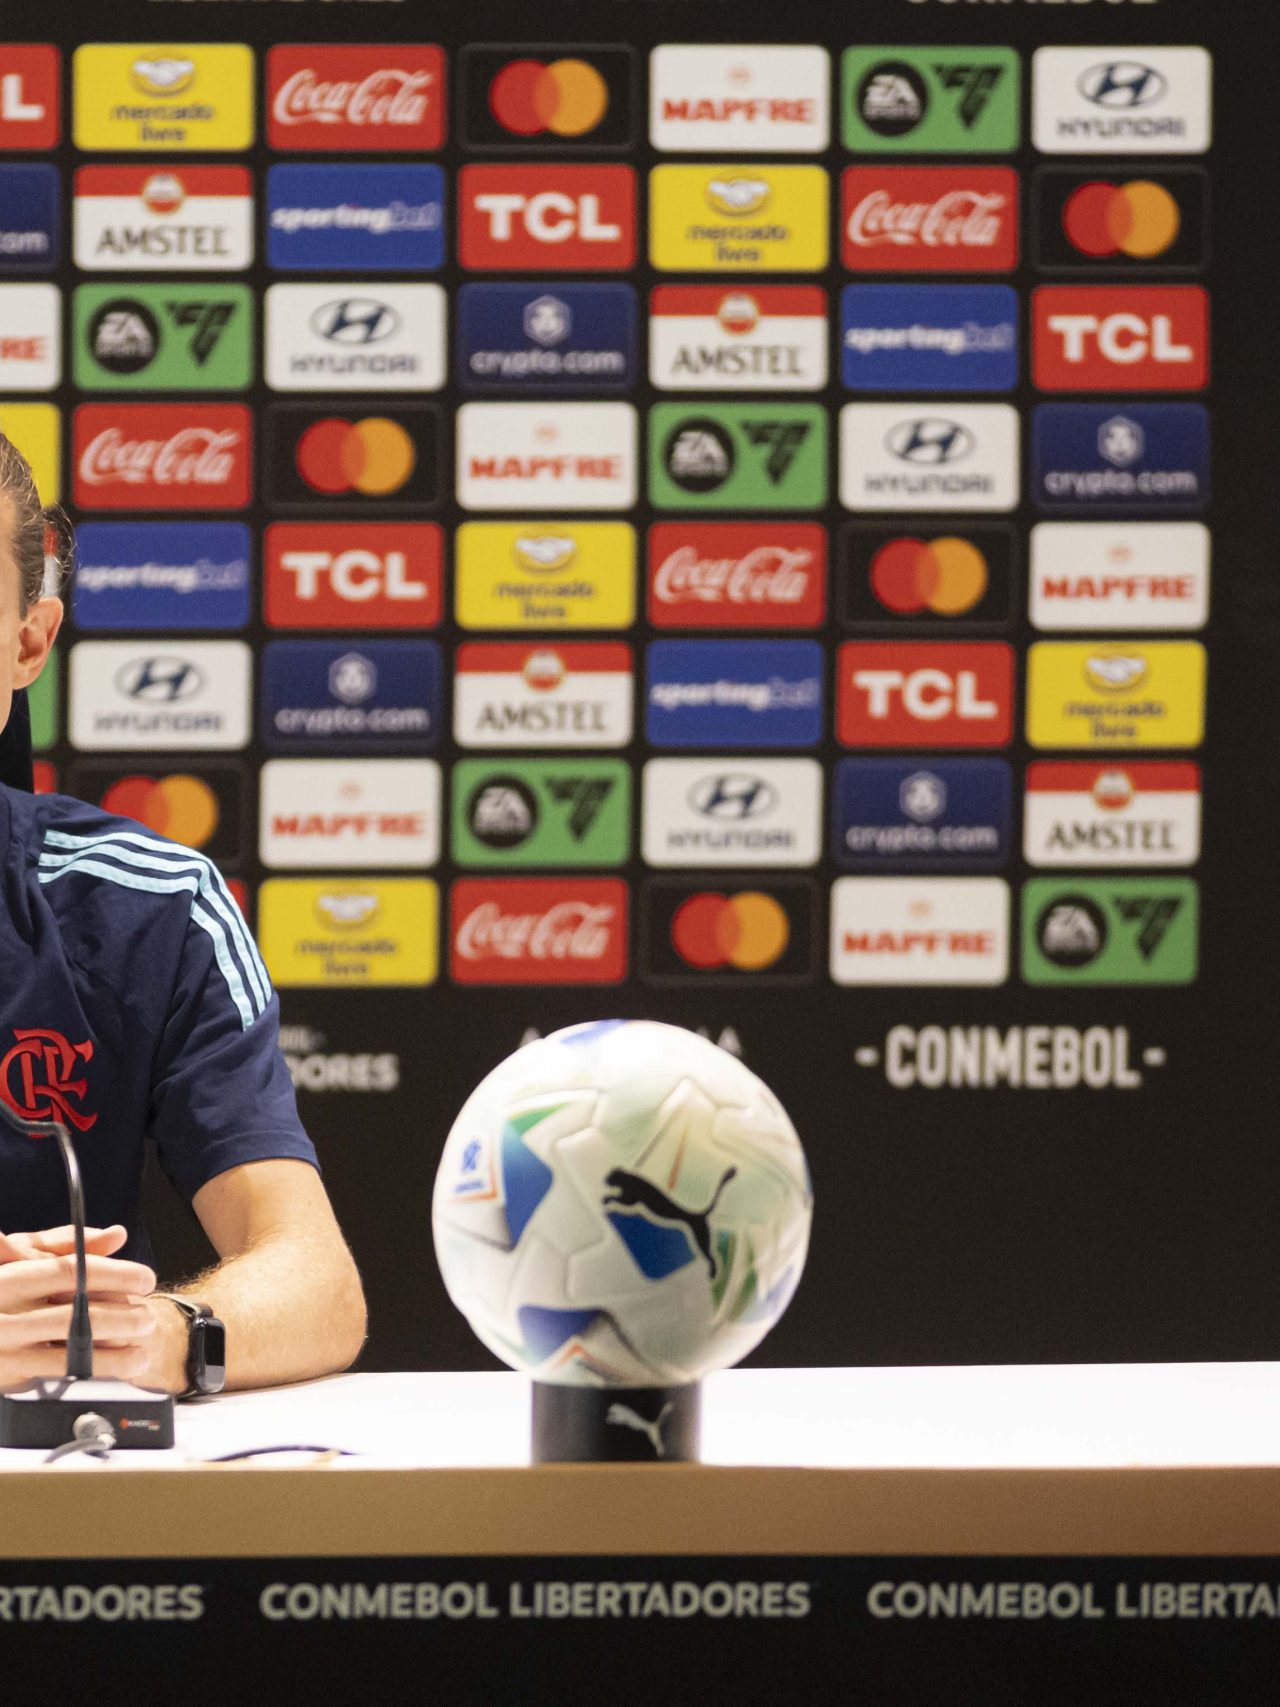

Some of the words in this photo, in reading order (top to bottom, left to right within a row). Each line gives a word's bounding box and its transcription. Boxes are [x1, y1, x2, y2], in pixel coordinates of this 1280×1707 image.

[661, 97, 816, 123] MAPFRE
[475, 192, 620, 242] TCL
[97, 226, 227, 256] AMSTEL
[1049, 314, 1192, 363] TCL
[471, 350, 623, 374] crypto.com
[673, 346, 804, 377] AMSTEL
[467, 455, 623, 481] MAPFRE
[1045, 470, 1196, 494] crypto.com
[281, 550, 426, 600] TCL
[1038, 574, 1192, 601] MAPFRE
[853, 669, 997, 719] TCL
[94, 712, 226, 733] HYUNDAI
[276, 708, 428, 732] crypto.com
[476, 702, 609, 734] AMSTEL
[271, 812, 427, 839] MAPFRE
[847, 826, 997, 850] crypto.com
[1045, 821, 1177, 852] AMSTEL
[841, 929, 996, 956] MAPFRE
[260, 1582, 498, 1619] CONMEBOL
[510, 1582, 810, 1618] LIBERTADORES
[868, 1582, 1103, 1618] CONMEBOL
[1117, 1583, 1280, 1618] LIBERTA
